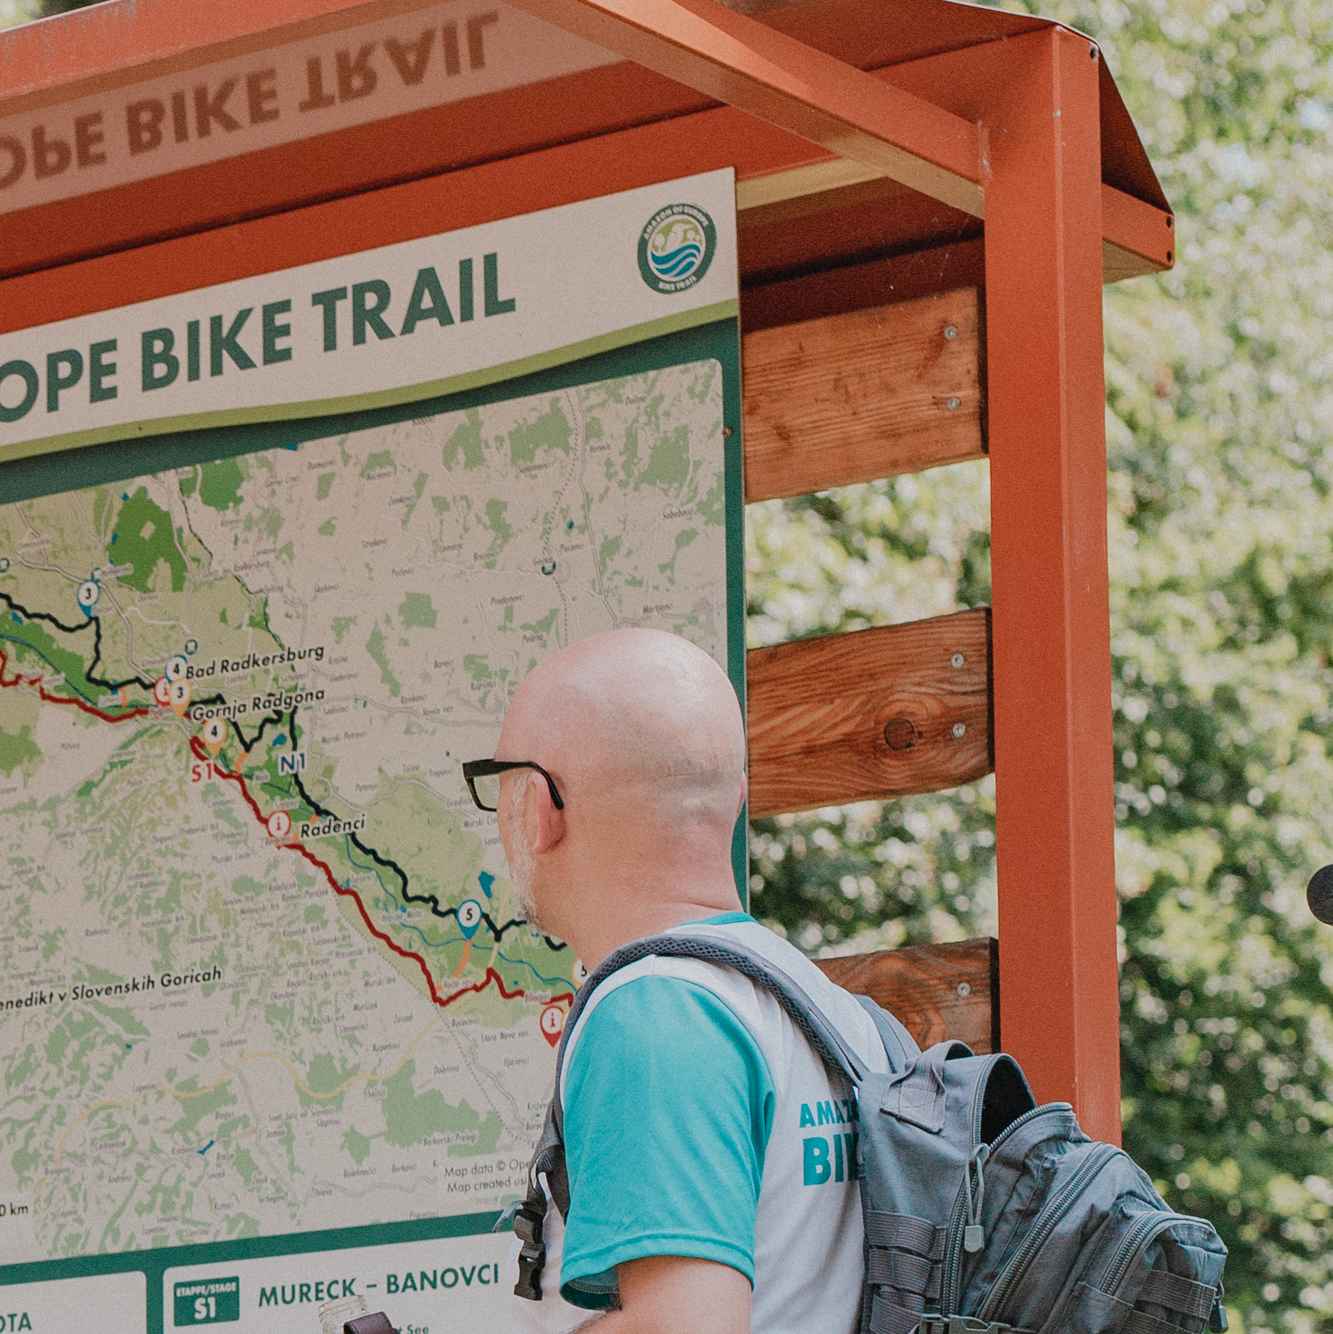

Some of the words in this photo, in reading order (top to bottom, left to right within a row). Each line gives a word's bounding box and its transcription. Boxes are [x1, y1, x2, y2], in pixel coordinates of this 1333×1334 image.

[141, 298, 293, 393] BIKE
[311, 251, 517, 354] TRAIL
[85, 587, 91, 599] 3
[173, 662, 180, 675] 4
[186, 665, 216, 680] Bad
[220, 645, 326, 676] Radkersburg
[177, 686, 184, 699] 3
[192, 699, 248, 722] Gornja
[211, 725, 218, 738] 4
[279, 752, 307, 775] N1
[191, 764, 212, 782] S1
[300, 813, 366, 840] Radenci
[465, 907, 473, 921] 5
[72, 978, 155, 1001] Slovenskih
[161, 966, 222, 990] Goricah
[445, 1166, 468, 1179] Map
[471, 1162, 493, 1175] data
[448, 1182, 471, 1195] Map
[474, 1176, 511, 1191] created
[9, 1203, 28, 1216] km
[176, 1282, 237, 1297] ETAPPE/STAGE
[258, 1277, 357, 1307] MURECK
[387, 1263, 499, 1294] BANOVCI
[194, 1296, 217, 1319] S1
